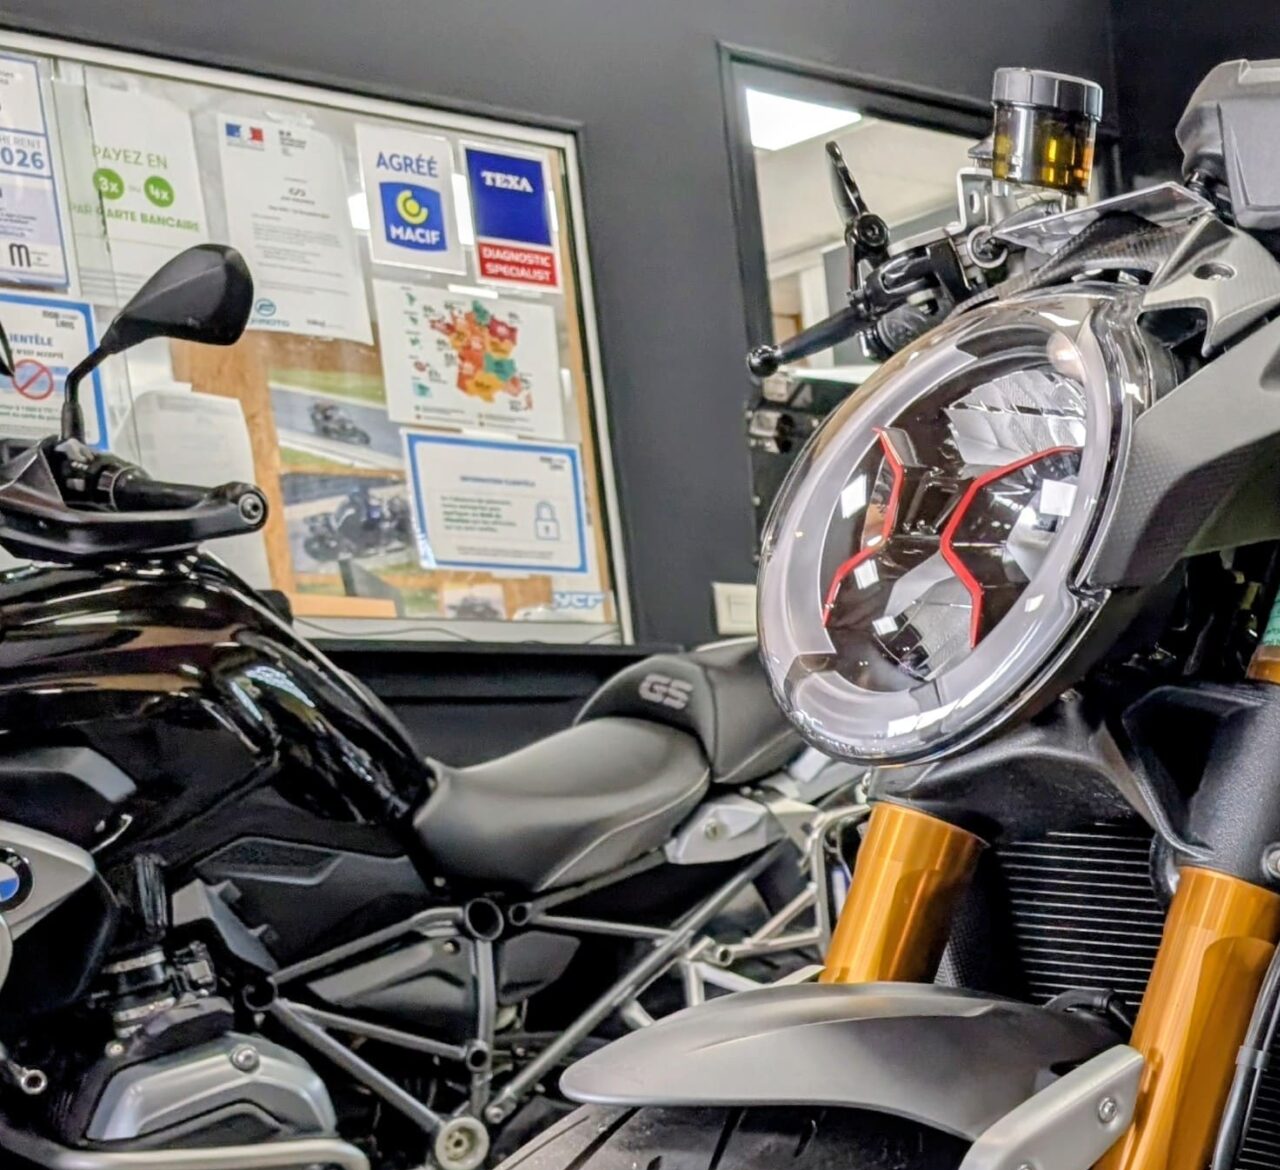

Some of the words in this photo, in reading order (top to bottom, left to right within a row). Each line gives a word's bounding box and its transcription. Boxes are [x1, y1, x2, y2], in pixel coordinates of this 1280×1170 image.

[0, 146, 44, 169] 026
[92, 144, 143, 166] PAYEZ
[147, 153, 168, 170] EN
[376, 151, 439, 178] AGRÉÉ
[481, 168, 534, 193] TEXA
[390, 224, 441, 245] MACIF
[482, 245, 552, 268] DIAGNOSTIC
[485, 261, 552, 281] SPECIALIST
[9, 333, 54, 347] IENTÈLE
[638, 673, 694, 710] GS
